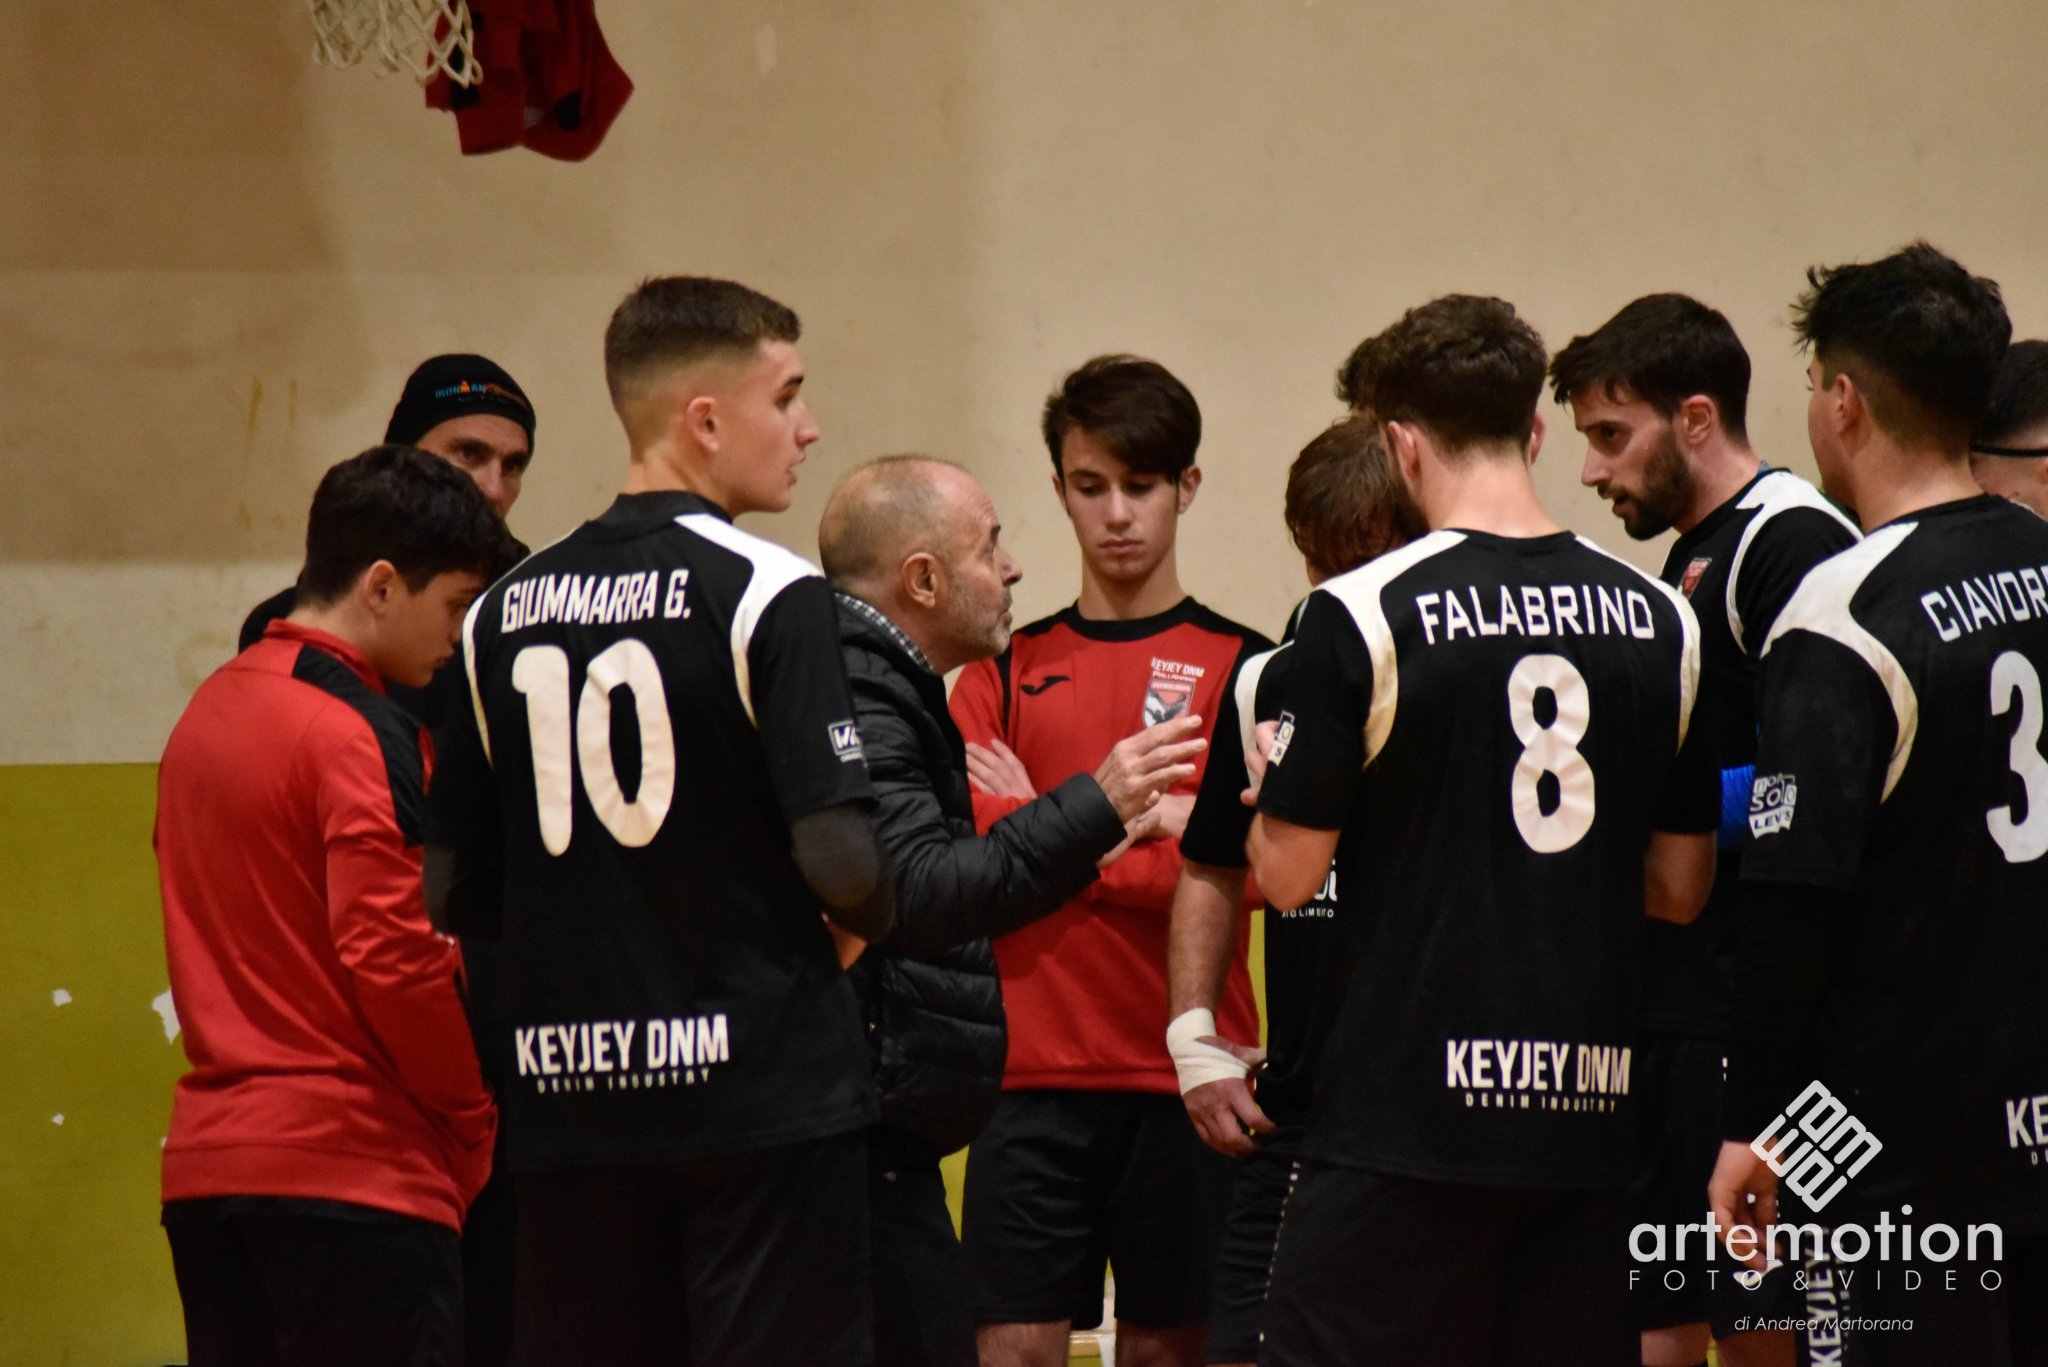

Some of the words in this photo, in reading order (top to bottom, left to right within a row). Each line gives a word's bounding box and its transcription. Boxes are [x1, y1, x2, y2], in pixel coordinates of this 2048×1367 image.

[501, 571, 659, 634] GIUMMARRA
[663, 569, 691, 619] G.
[1416, 585, 1654, 645] FALABRINO
[1920, 566, 2048, 642] CIAVOR
[511, 638, 676, 857] 10
[1508, 654, 1595, 853] 8
[1987, 651, 2048, 863] 3
[515, 1020, 636, 1077] KEYJEY
[647, 1014, 729, 1070] DNM
[1447, 1039, 1570, 1092] KEYJEY
[1576, 1044, 1632, 1095] DNM
[608, 1067, 710, 1091] INDUSTRY
[1465, 1092, 1529, 1109] DENIM
[1542, 1096, 1616, 1113] INDUSTRY
